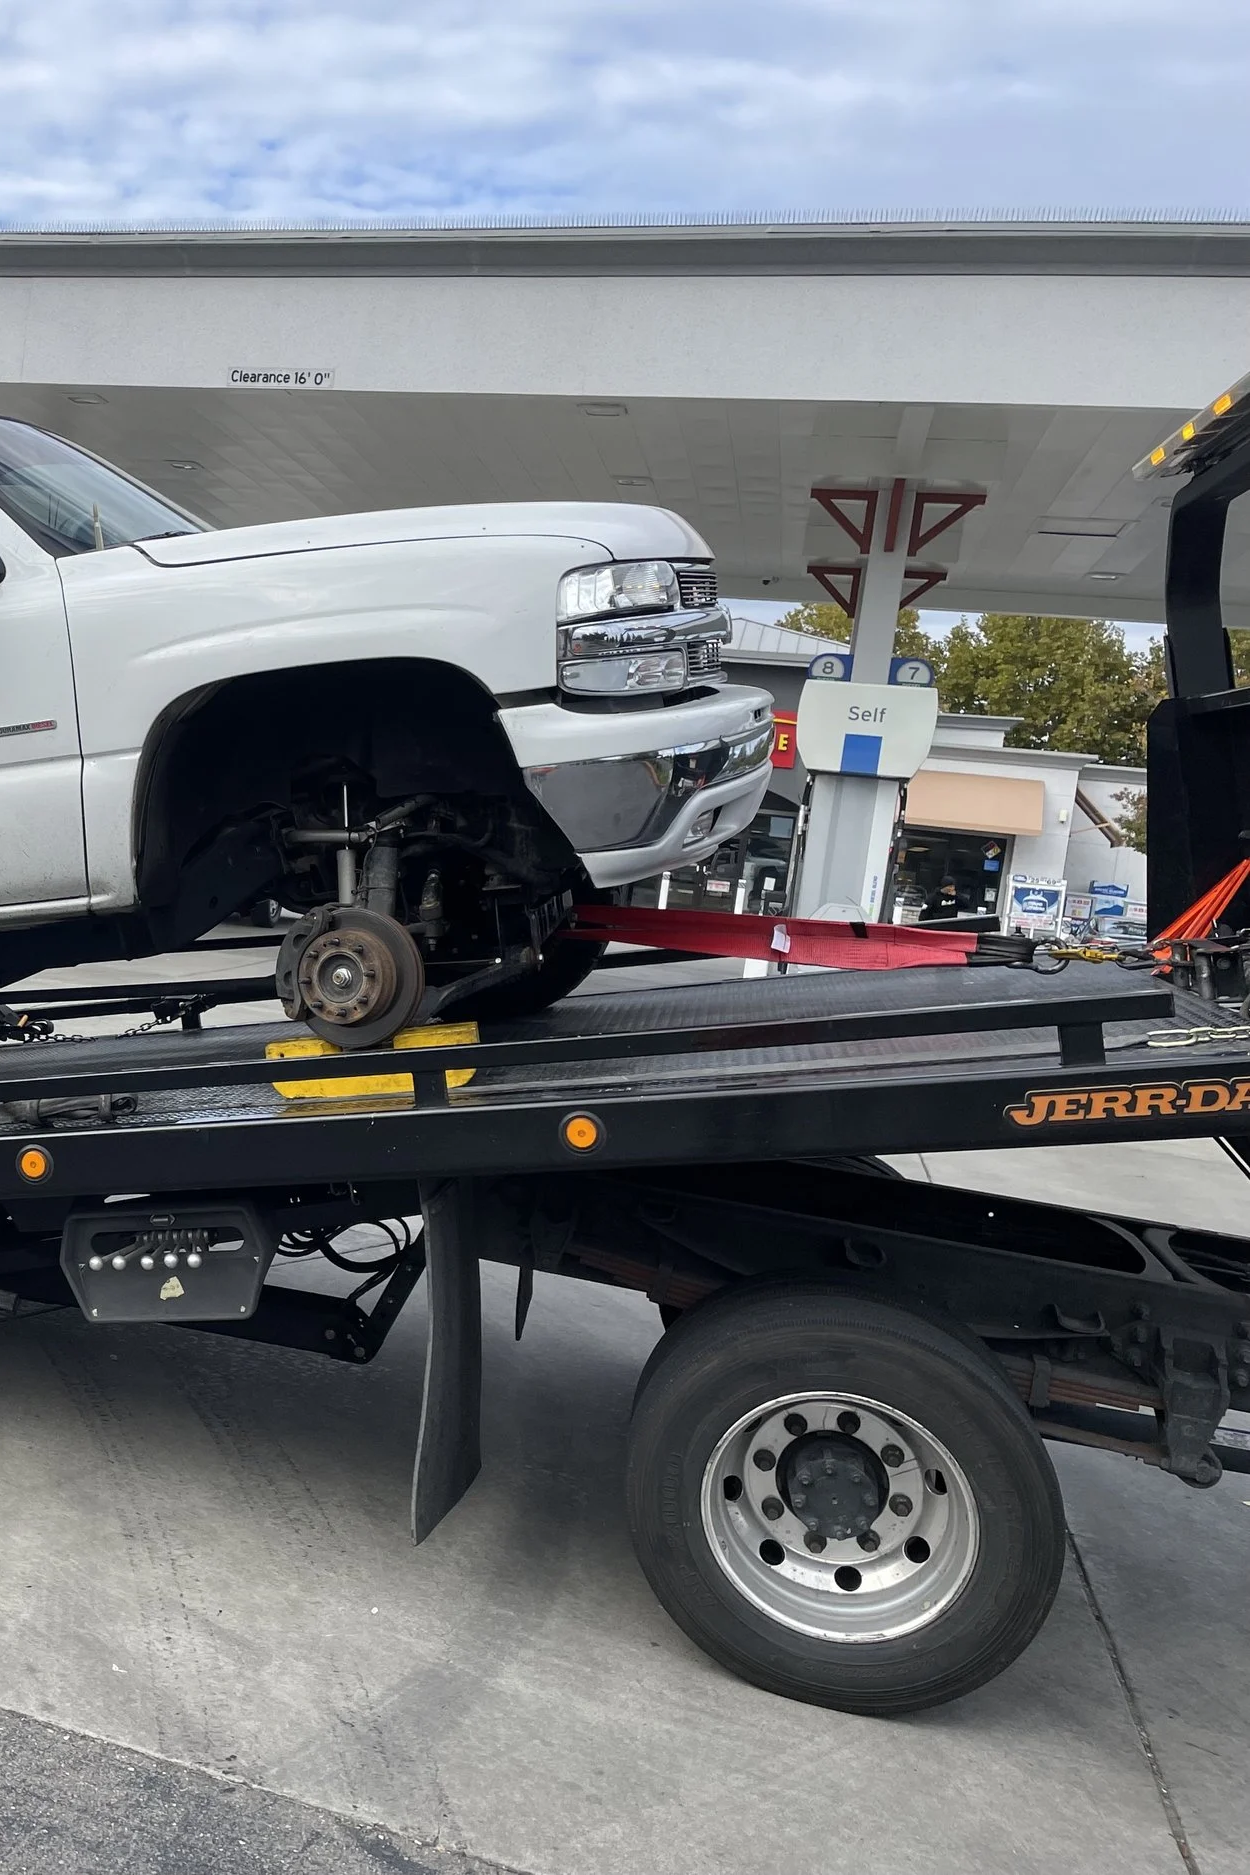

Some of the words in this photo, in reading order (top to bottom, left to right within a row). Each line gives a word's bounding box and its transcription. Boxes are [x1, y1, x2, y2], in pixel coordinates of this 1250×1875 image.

[231, 369, 291, 384] Clearance
[822, 661, 835, 675] 8
[908, 666, 920, 680] 7
[848, 706, 887, 723] Self
